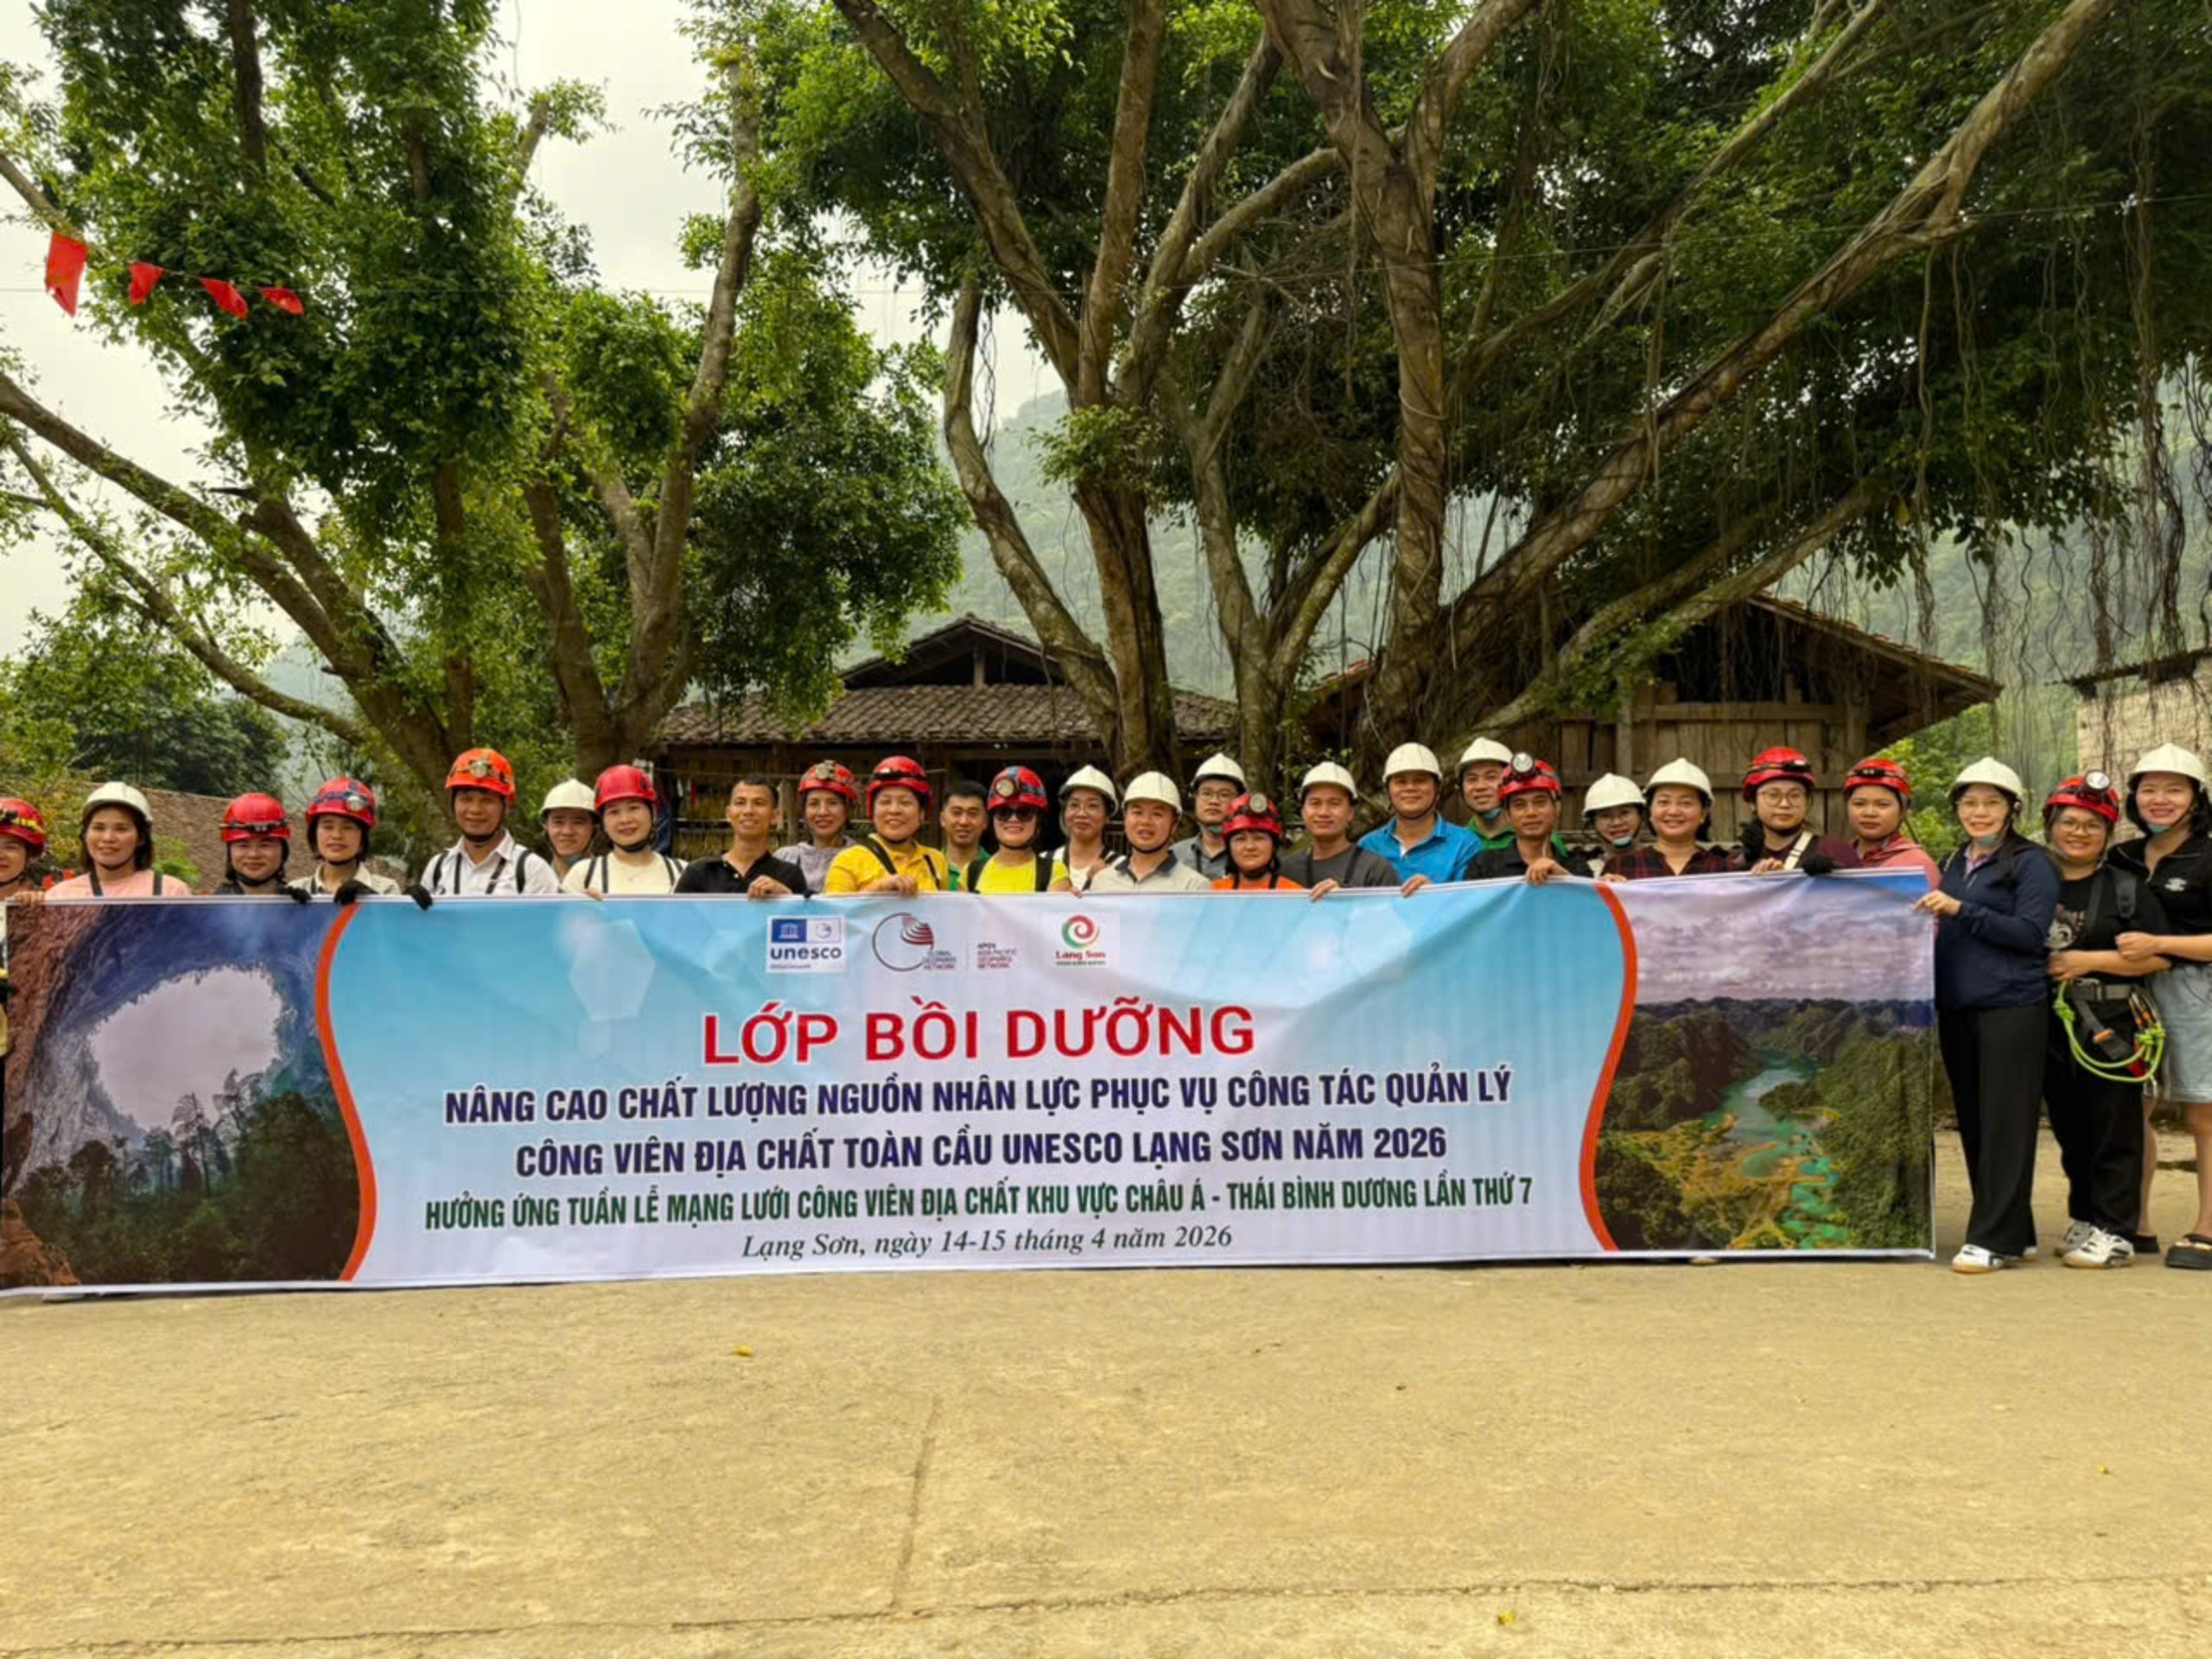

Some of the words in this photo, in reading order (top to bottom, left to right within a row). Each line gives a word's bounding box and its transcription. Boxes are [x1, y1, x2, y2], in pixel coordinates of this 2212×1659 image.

[770, 947, 842, 960] unesco
[704, 1001, 839, 1065] LỚP
[867, 995, 979, 1063] BỒI
[1007, 996, 1255, 1059] DƯỠNG
[445, 1084, 535, 1124] NÂNG
[545, 1089, 607, 1122] CAO
[618, 1076, 698, 1120] CHẤT
[708, 1082, 807, 1123] LƯỢNG
[817, 1071, 923, 1116] NGUỒN
[932, 1074, 1016, 1112] NHÂN
[1026, 1076, 1081, 1117] LỰC
[1090, 1077, 1170, 1116] PHỤC
[1179, 1077, 1217, 1116] VỤ
[1227, 1069, 1311, 1109] CÔNG
[1319, 1067, 1376, 1106] TÁC
[1385, 1062, 1468, 1108] QUẢN
[1478, 1064, 1511, 1102] LÝ
[516, 1138, 603, 1178] CÔNG
[613, 1135, 685, 1174] VIÊN
[694, 1140, 747, 1179] ĐỊA
[757, 1127, 835, 1171] CHẤT
[842, 1131, 923, 1169] TOÀN
[932, 1123, 992, 1166] CẦU
[1002, 1131, 1122, 1166] UNESCO
[1133, 1131, 1211, 1171] LẠNG
[1221, 1127, 1283, 1162] SƠN
[1293, 1122, 1363, 1160] NĂM
[1373, 1126, 1446, 1159] 2026
[425, 1190, 505, 1230] HƯỞNG
[512, 1192, 560, 1228] ỨNG
[567, 1186, 626, 1226] TUẦN
[633, 1185, 659, 1224] LỄ
[666, 1192, 734, 1229] MẠNG
[741, 1185, 791, 1221] LƯỚI
[798, 1184, 858, 1219] CÔNG
[864, 1183, 915, 1217] VIÊN
[920, 1187, 958, 1222] ĐỊA
[964, 1176, 1020, 1216] CHẤT
[1027, 1185, 1070, 1214] KHU
[1076, 1181, 1119, 1220] VỰC
[1125, 1178, 1184, 1213] CHÂU
[1190, 1177, 1205, 1211] Á
[1226, 1176, 1275, 1211] THÁI
[1282, 1175, 1335, 1210] BÌNH
[1341, 1177, 1417, 1209] DƯƠNG
[1423, 1169, 1466, 1207] LẦN
[1471, 1171, 1516, 1206] THỨ
[1519, 1177, 1533, 1205] 7
[742, 1235, 805, 1262] Lạng
[811, 1233, 866, 1256] Sơn,
[874, 1230, 932, 1259] ngày
[941, 1229, 1006, 1252] 14-15
[1014, 1228, 1084, 1255] tháng
[1090, 1228, 1106, 1249] 4
[1113, 1228, 1166, 1249] năm
[1174, 1224, 1232, 1248] 2026
